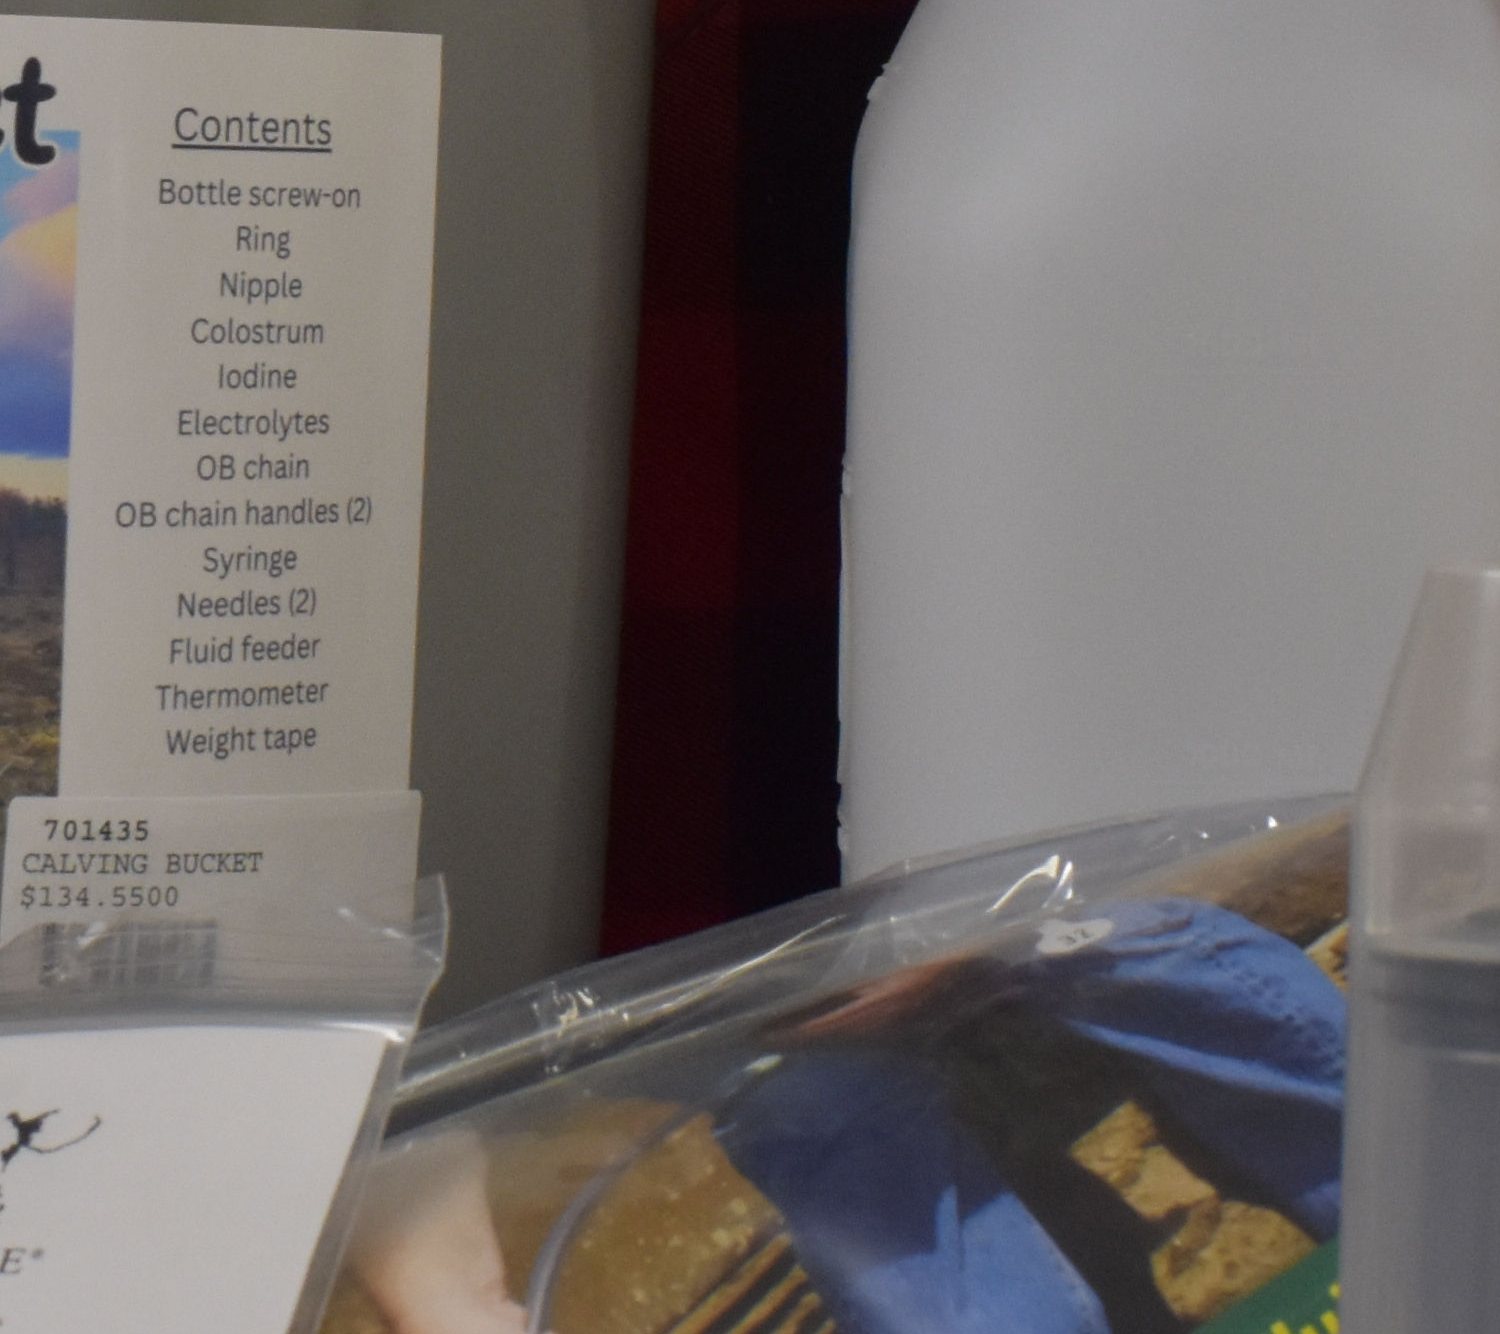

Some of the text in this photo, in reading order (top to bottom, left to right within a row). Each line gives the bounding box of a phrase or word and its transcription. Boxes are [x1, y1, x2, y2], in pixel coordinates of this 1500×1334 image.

[173, 108, 332, 146] Contents
[159, 179, 360, 208] Bottle screw-on
[236, 226, 290, 259] Ring
[220, 272, 302, 304] Nipple
[191, 318, 324, 344] Colostrum
[218, 362, 297, 389] Iodine
[178, 409, 329, 441] Electrolytes
[197, 453, 309, 480] OB chain
[116, 497, 372, 528] OB chain handles (2)
[202, 546, 297, 578] Syringe
[177, 588, 316, 617] Needles (2)
[170, 634, 320, 664] Fluid feeder
[156, 682, 328, 710] Thermometer
[166, 727, 316, 760] Weight tape
[44, 820, 149, 842] 701435
[22, 852, 263, 875] CALVING BUCKET
[19, 886, 179, 909] $134.5500
